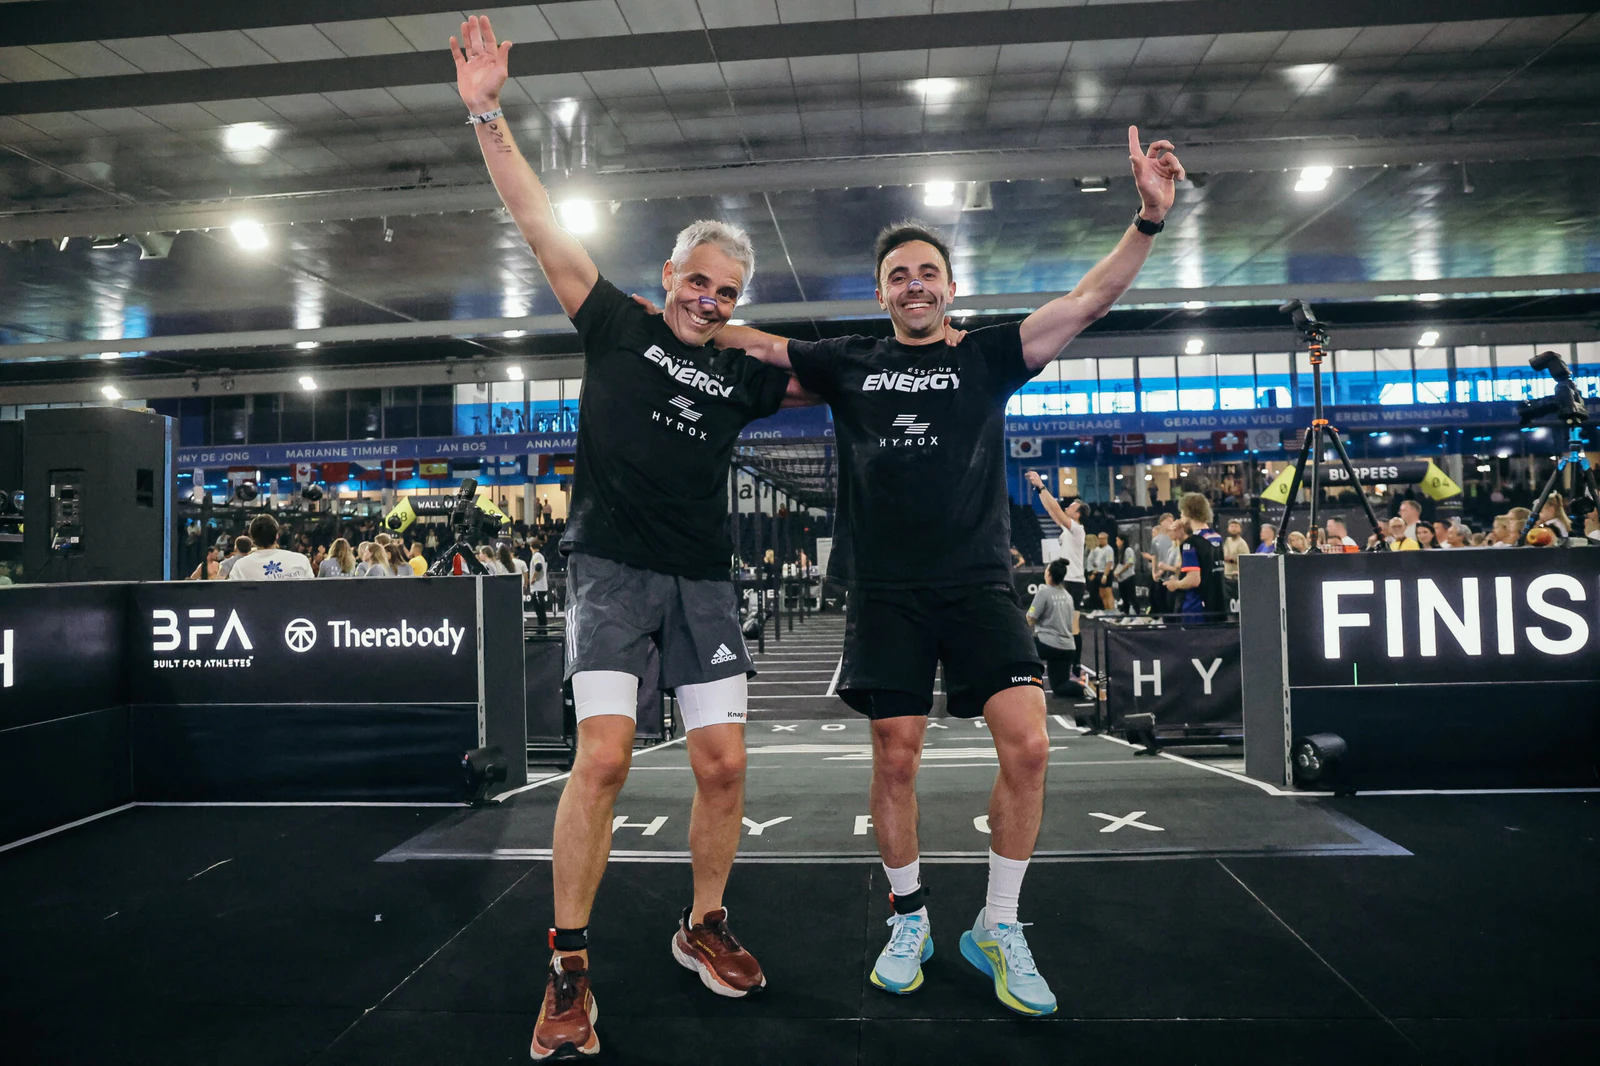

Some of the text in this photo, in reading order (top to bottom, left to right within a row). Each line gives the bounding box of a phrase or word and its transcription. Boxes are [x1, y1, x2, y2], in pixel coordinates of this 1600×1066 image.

[643, 344, 734, 398] ENERGY
[862, 373, 960, 392] ENERGY
[652, 410, 708, 441] HYROX
[1032, 419, 1122, 431] UYTDEHAAGE
[1163, 413, 1294, 428] GERARD VAN VELDE
[436, 441, 487, 453] JAN BOS
[879, 436, 938, 448] HYROX
[201, 453, 216, 462] DE
[219, 451, 250, 462] JONG
[286, 445, 398, 459] MARIANNE TIMMER
[1328, 466, 1399, 481] BURPEES
[417, 500, 441, 509] WALL
[1321, 573, 1590, 660] FINIS
[152, 608, 254, 651] BFA
[327, 618, 466, 656] Therabody
[153, 659, 180, 669] BUILT
[182, 659, 202, 668] FOR
[710, 653, 738, 665] adidas
